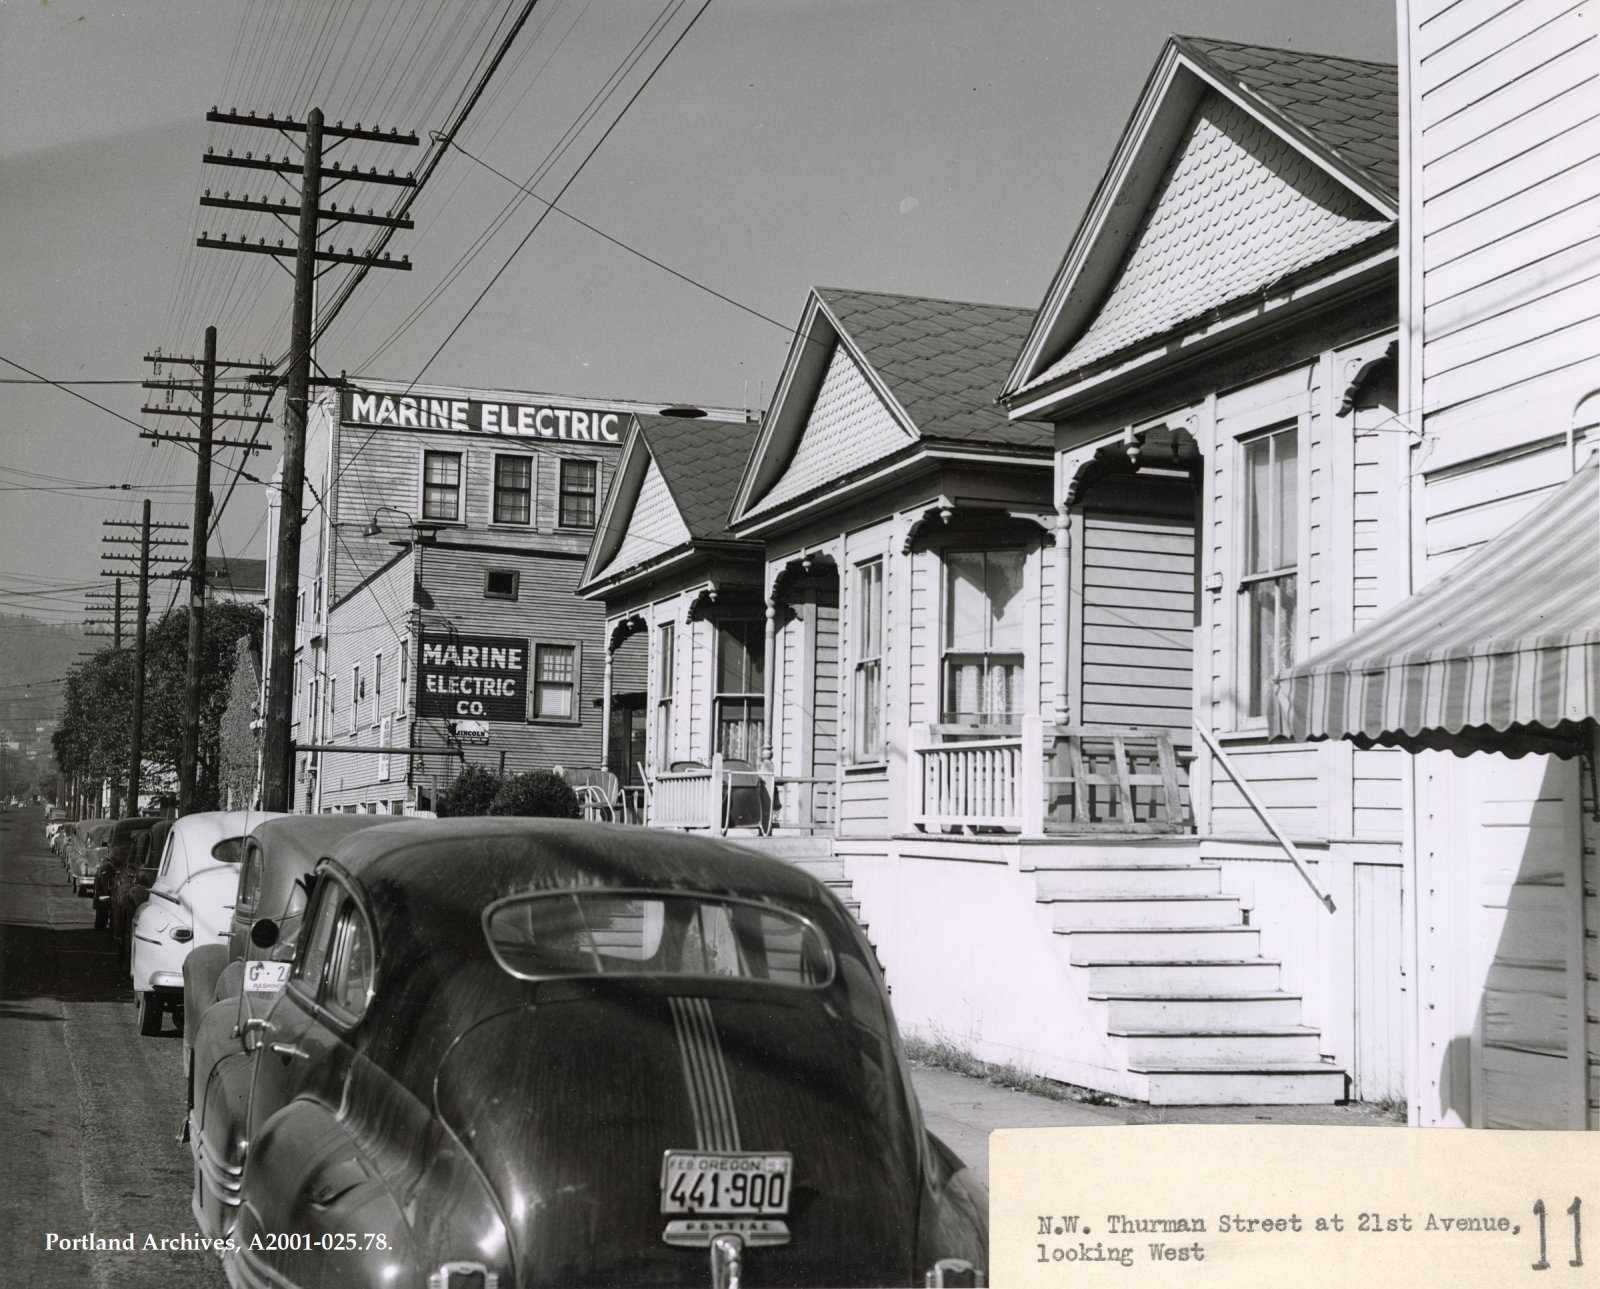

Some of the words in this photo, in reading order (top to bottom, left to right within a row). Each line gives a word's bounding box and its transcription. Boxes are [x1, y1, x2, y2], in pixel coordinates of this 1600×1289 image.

[352, 393, 470, 431] MARINE
[481, 403, 619, 441] ELECTRIC
[423, 643, 522, 670] MARINE
[426, 674, 515, 697] ELECTRIC
[456, 700, 487, 716] CO.
[698, 1159, 761, 1171] OREGON
[686, 1222, 770, 1231] PONTIAC
[1037, 1215, 1091, 1235] N.W.
[1107, 1215, 1207, 1234] Thurman
[1219, 1214, 1302, 1233] Street
[1315, 1214, 1344, 1232] at
[1358, 1213, 1412, 1232] 21st
[1425, 1213, 1521, 1235] Avenue,
[1037, 1242, 1133, 1267] looking
[1150, 1242, 1205, 1262] West
